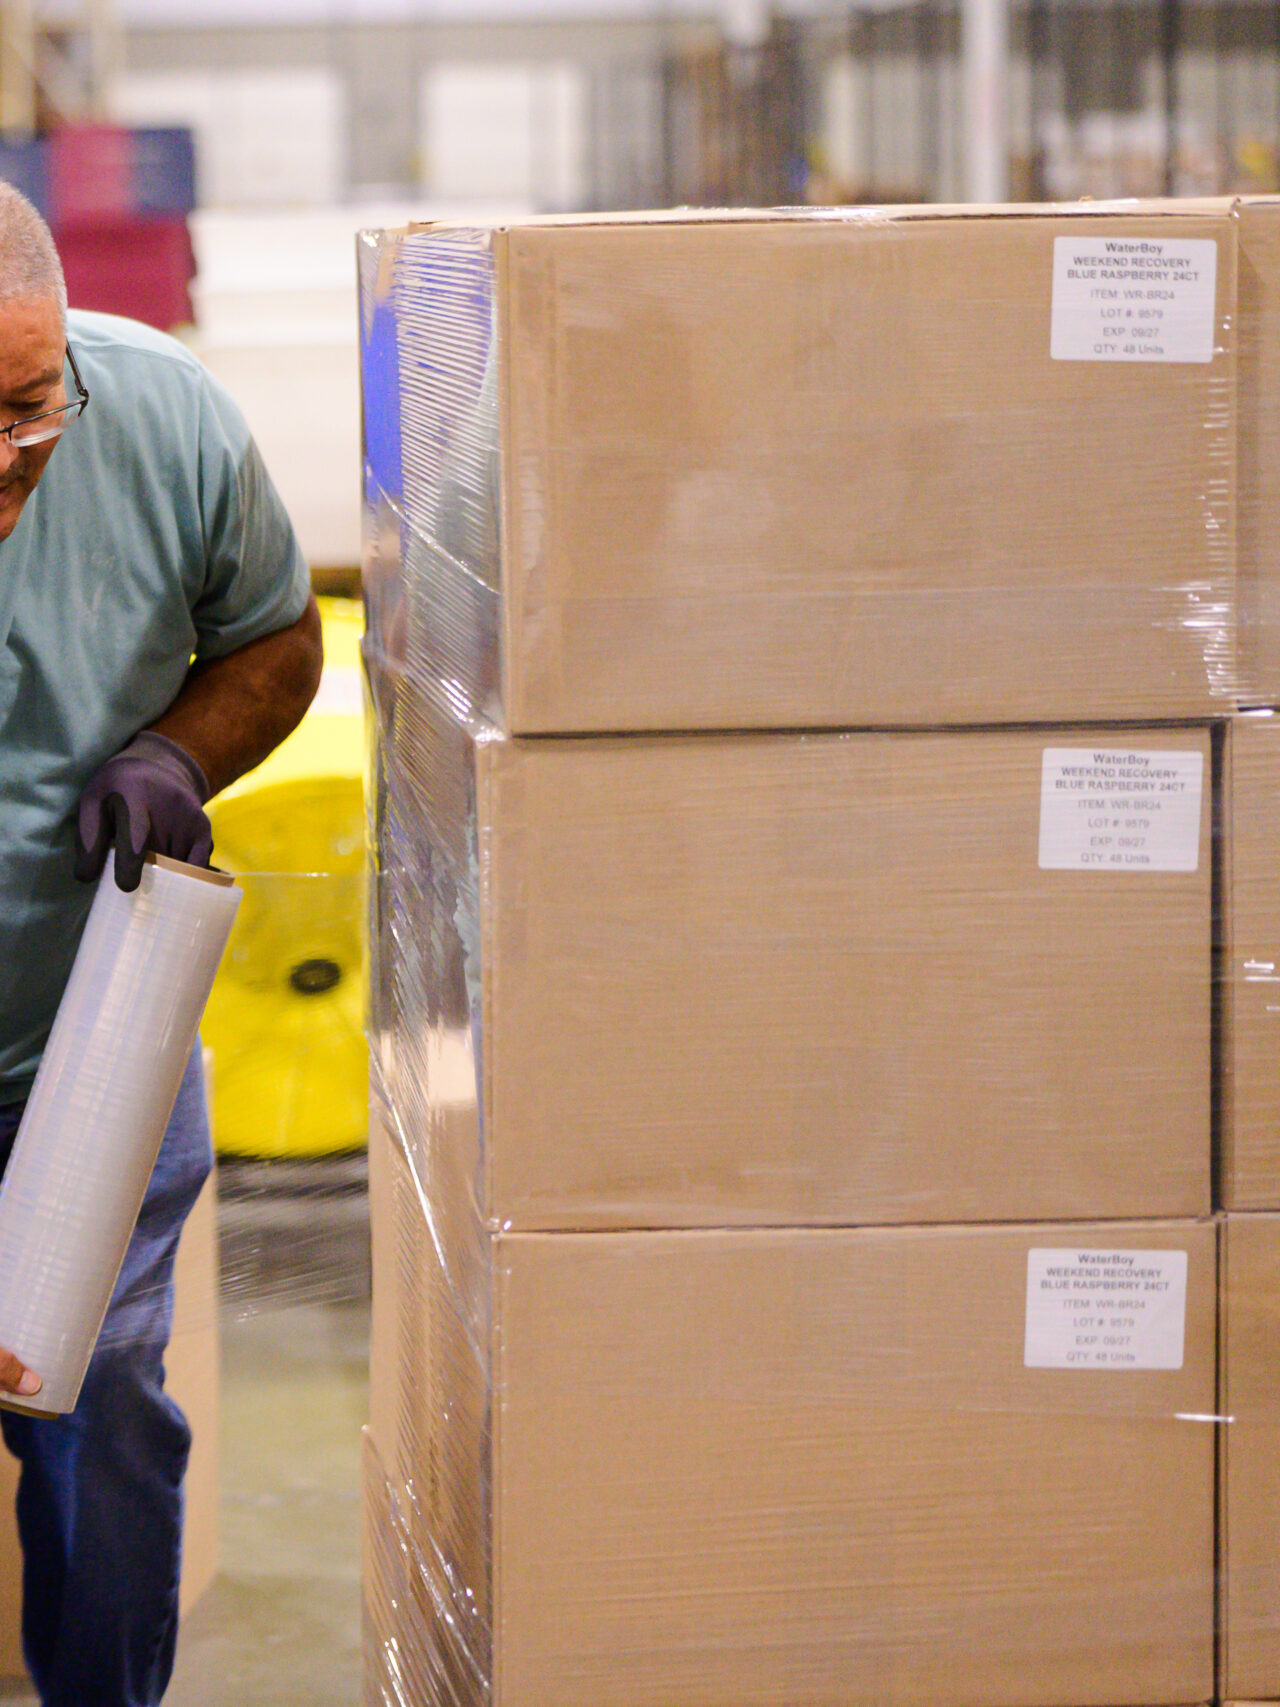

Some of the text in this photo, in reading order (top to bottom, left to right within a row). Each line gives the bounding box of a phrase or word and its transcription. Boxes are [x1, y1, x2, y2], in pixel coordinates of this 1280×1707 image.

[1106, 242, 1163, 254] WaterBoy
[1073, 256, 1191, 268] WEEKEND RECOVERY
[1067, 269, 1199, 281] BLUE RASPBERRY 24CT
[1100, 309, 1121, 318] LOT
[1139, 344, 1164, 354] Units
[1093, 753, 1150, 767] WaterBoy
[1061, 767, 1178, 779] WEEKEND RECOVERY
[1055, 780, 1185, 792] BLUE RASPBERRY 24CT
[1088, 818, 1109, 828] LOT
[1125, 854, 1150, 864] Units
[1078, 1254, 1135, 1266] WaterBoy
[1046, 1268, 1162, 1278] WEEKEND RECOVERY
[1041, 1280, 1169, 1291] BLUE RASPBERRY 24CT
[1073, 1318, 1094, 1327] LOT
[1110, 1353, 1136, 1362] Units
